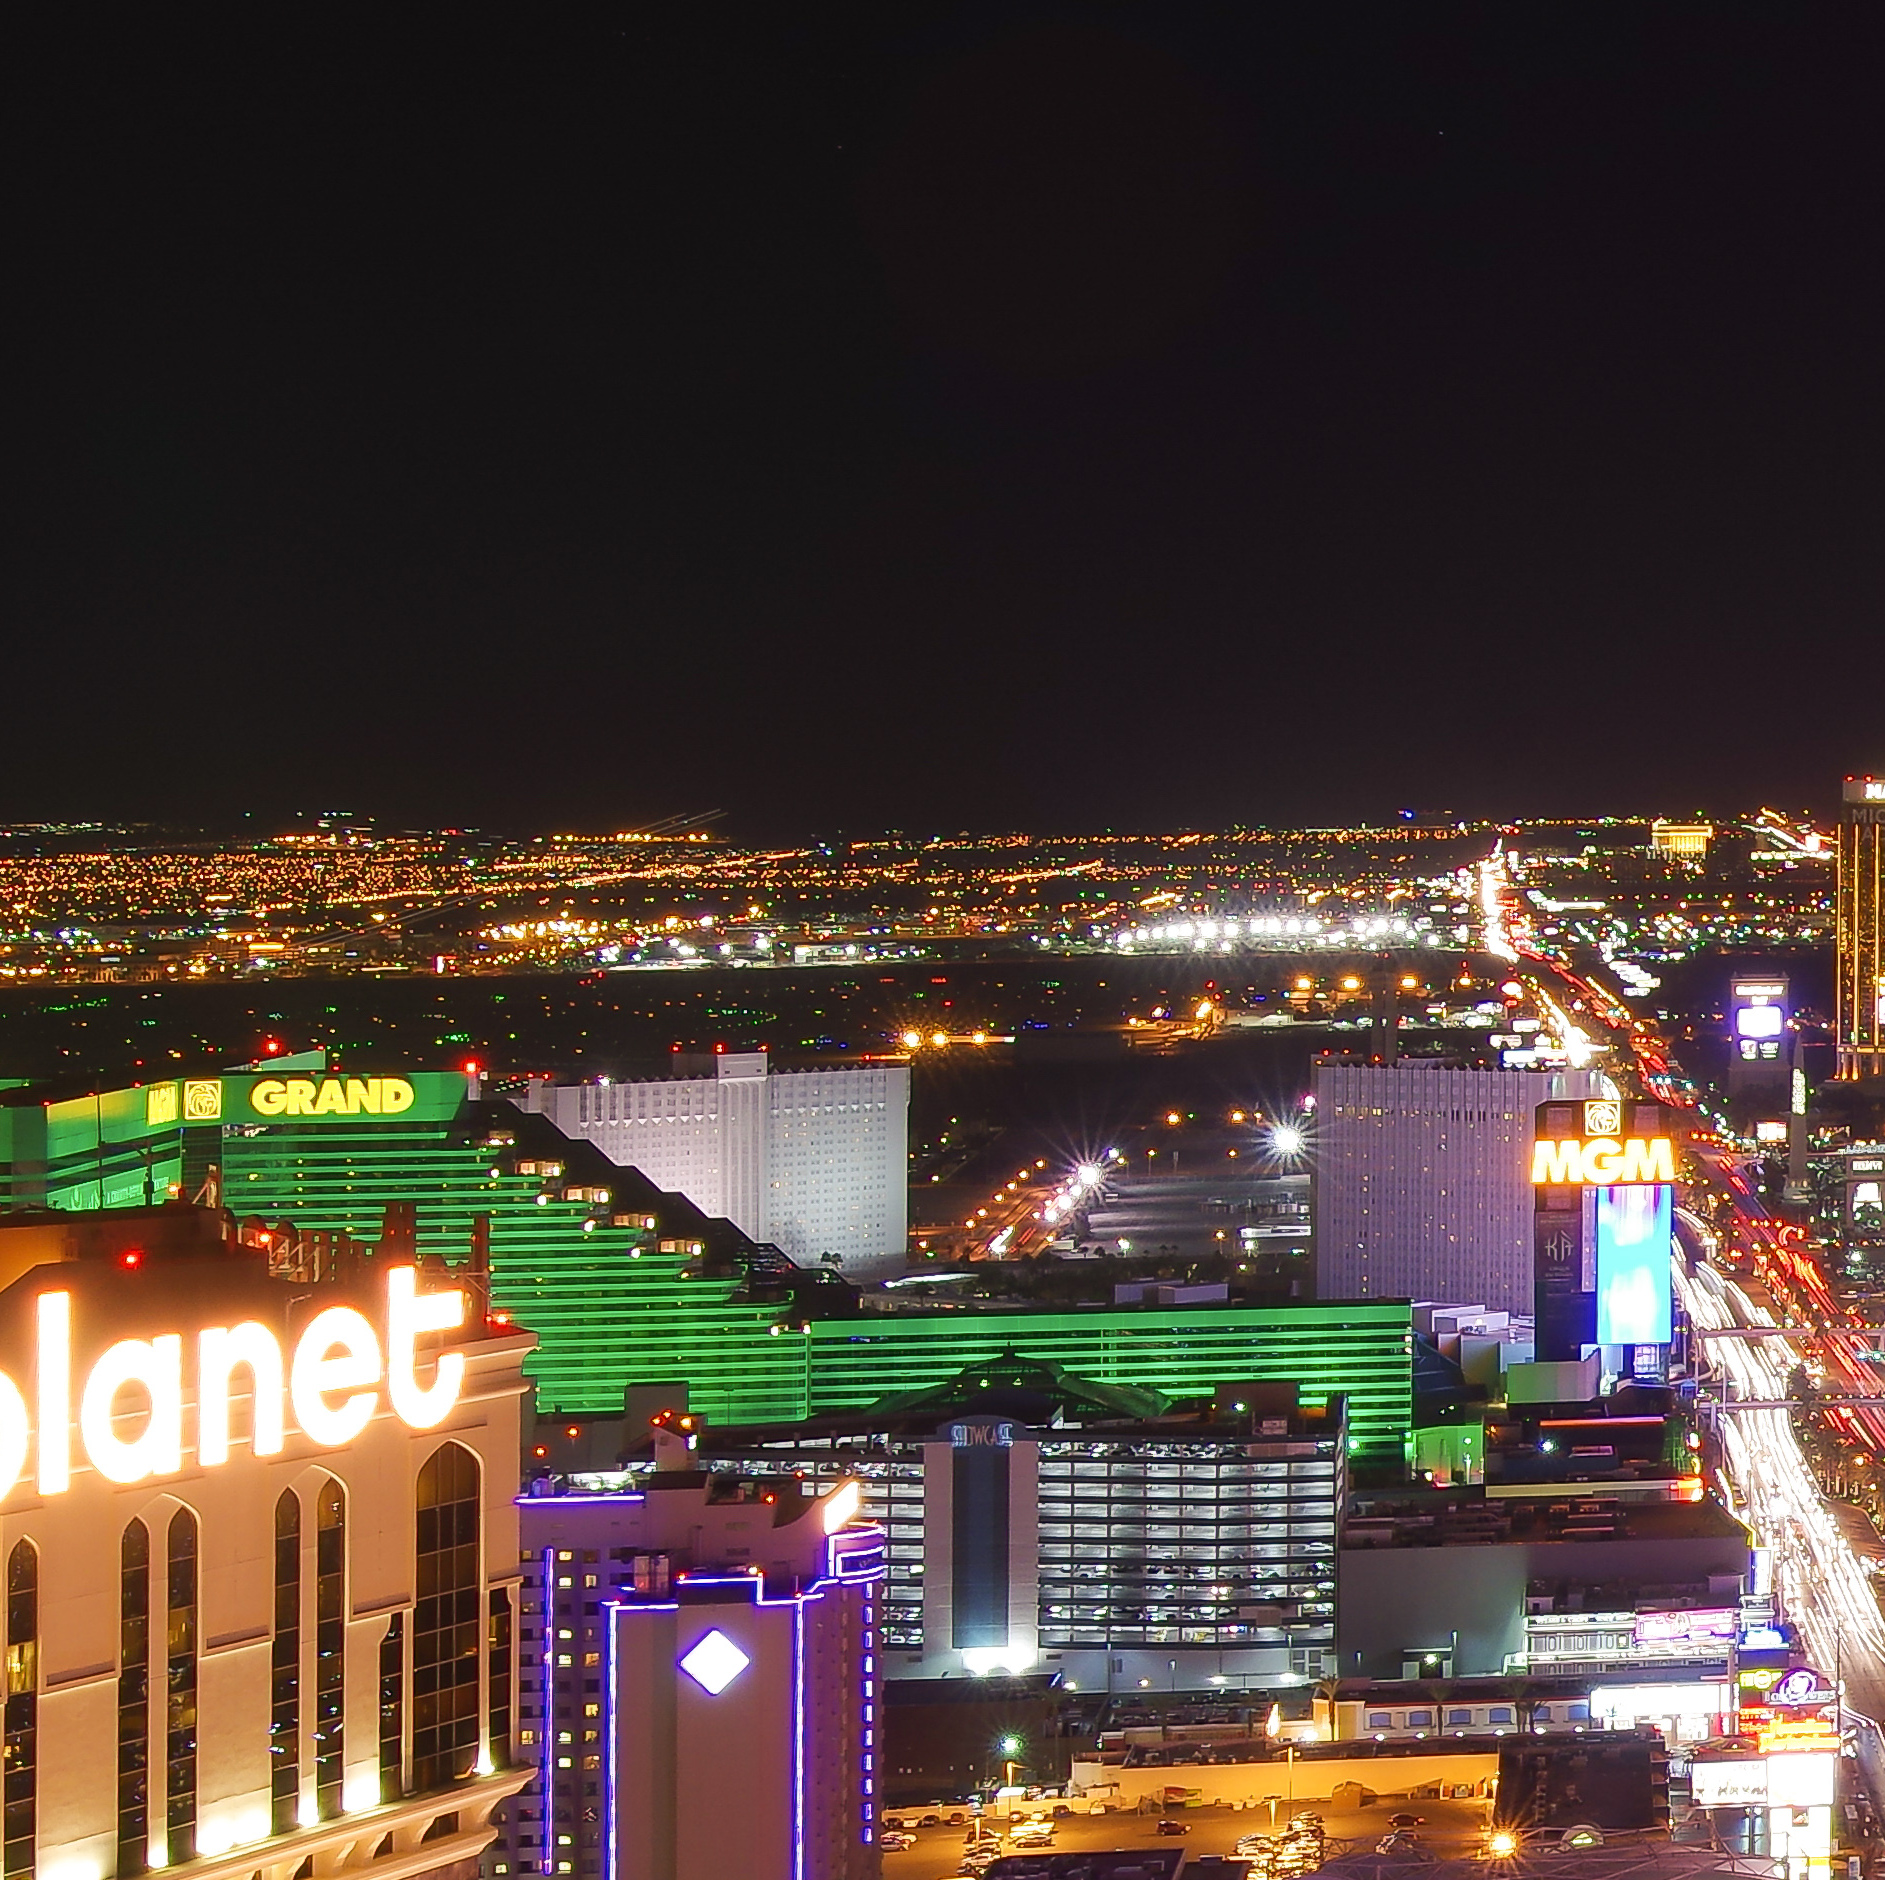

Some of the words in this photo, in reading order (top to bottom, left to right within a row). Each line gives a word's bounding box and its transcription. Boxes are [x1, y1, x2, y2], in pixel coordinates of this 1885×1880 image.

[251, 1078, 415, 1115] GRAND
[1531, 1138, 1674, 1184] MGM
[0, 1265, 466, 1500] lanet
